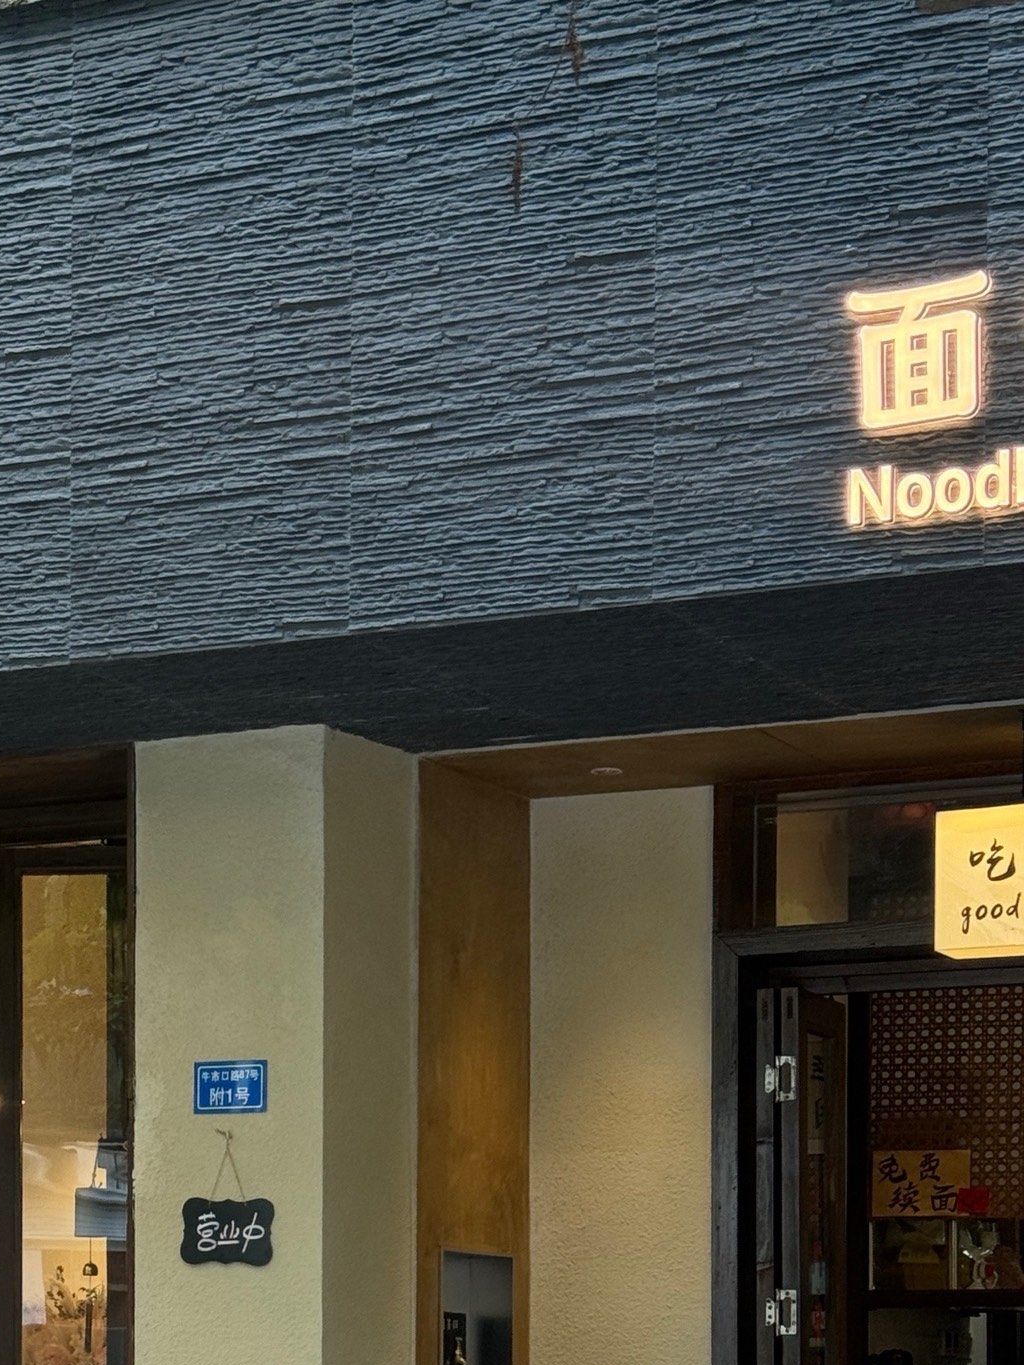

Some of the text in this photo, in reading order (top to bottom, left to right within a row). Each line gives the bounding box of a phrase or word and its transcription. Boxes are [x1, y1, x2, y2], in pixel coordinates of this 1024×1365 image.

[848, 270, 990, 428] 面
[969, 838, 1016, 881] 吃
[961, 892, 1022, 934] good
[201, 1069, 260, 1083] 牛市口路87号
[209, 1087, 250, 1106] 附1号
[197, 1212, 265, 1253] 营业中
